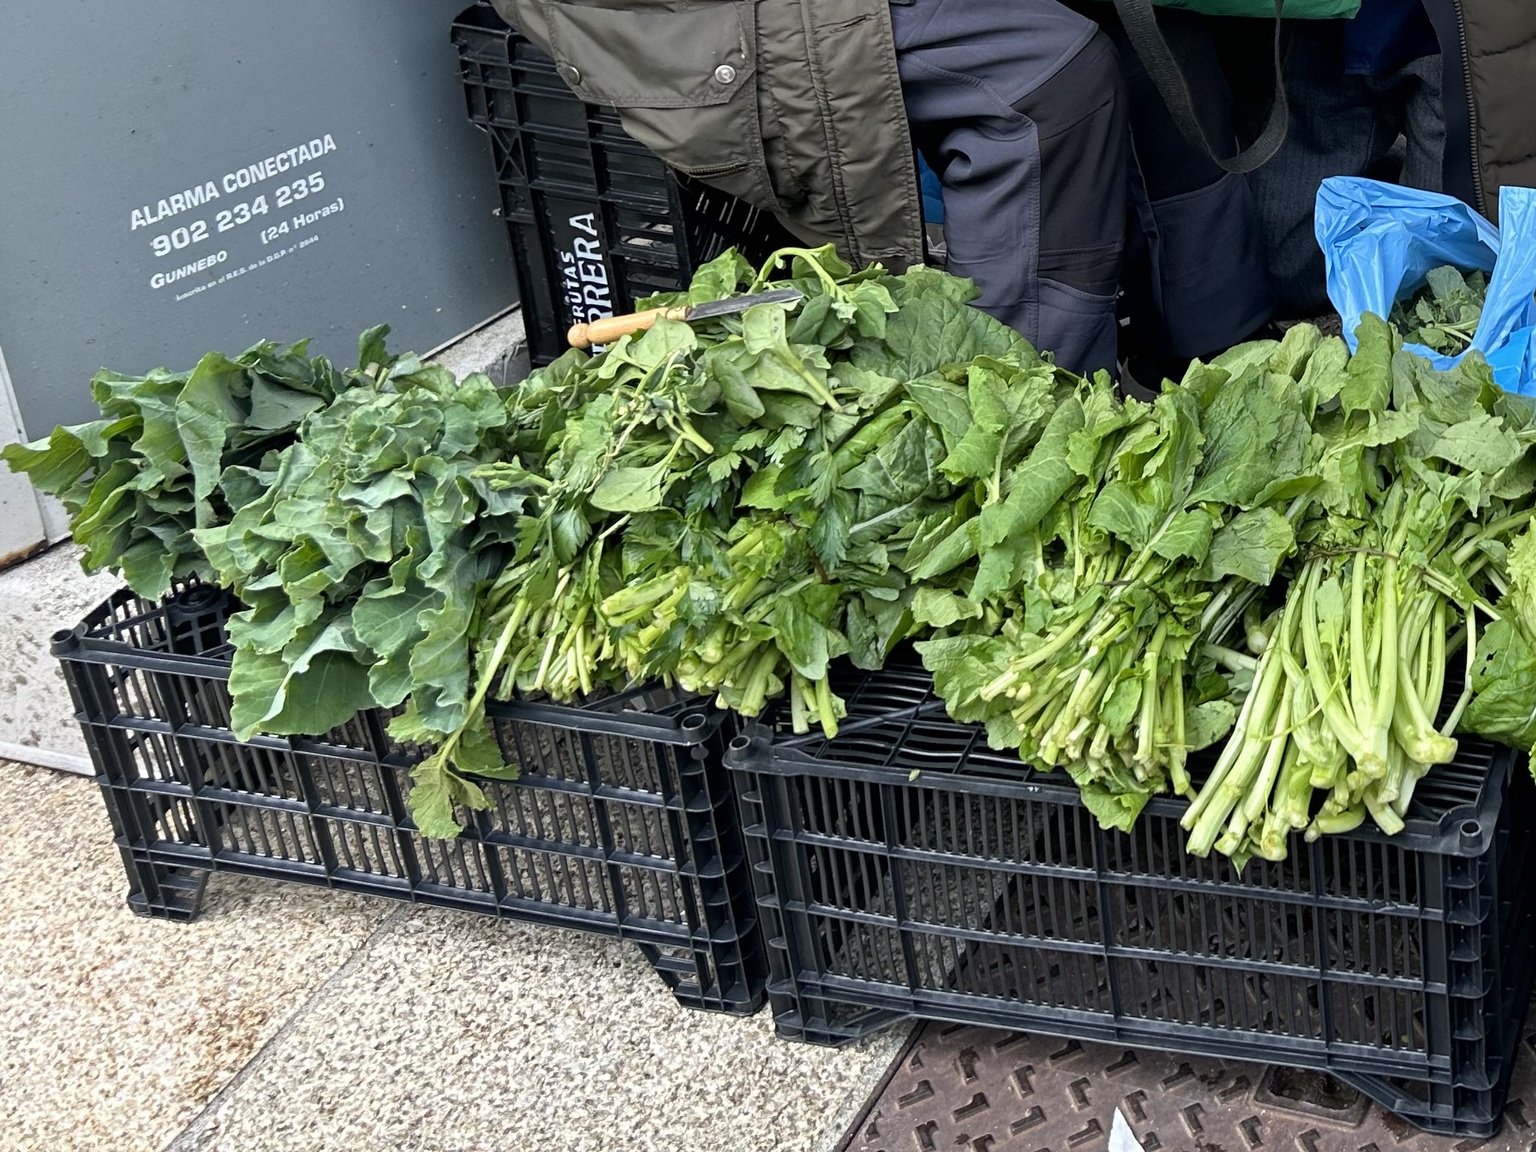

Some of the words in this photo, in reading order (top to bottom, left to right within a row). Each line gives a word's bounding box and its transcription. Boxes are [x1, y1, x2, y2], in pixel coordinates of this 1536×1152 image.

[131, 181, 220, 231] ALARMA
[223, 134, 338, 194] CONECTADA
[153, 219, 210, 257] 902
[216, 195, 269, 233] 234
[275, 171, 325, 208] 235
[150, 250, 228, 289] GUNNEBO
[260, 224, 290, 245] (24
[293, 197, 344, 228] Horas)
